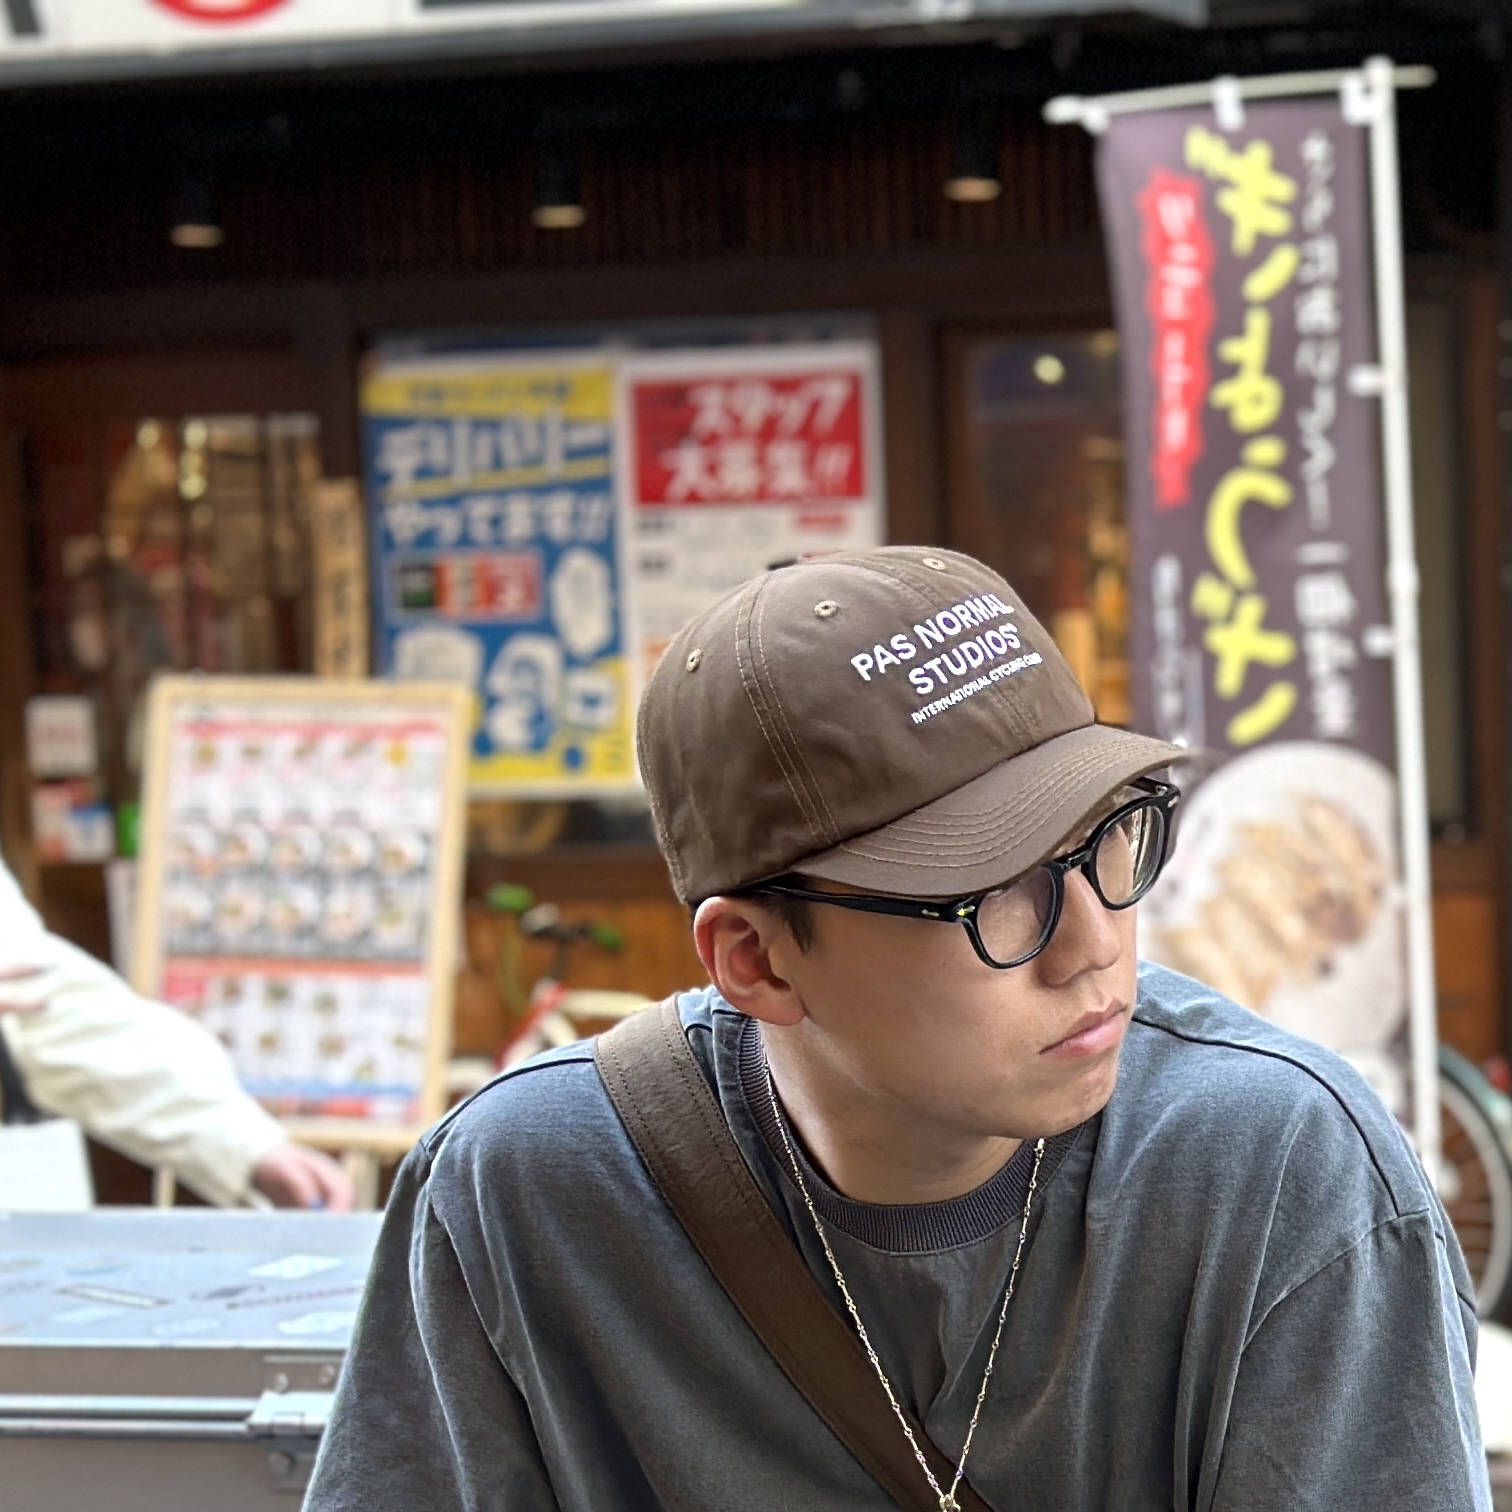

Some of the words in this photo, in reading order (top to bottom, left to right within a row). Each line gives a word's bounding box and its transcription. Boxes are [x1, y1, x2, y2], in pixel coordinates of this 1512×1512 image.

[688, 375, 852, 437] スタッフ
[376, 405, 611, 492] デリバリー
[850, 633, 917, 681] PAS
[913, 593, 1015, 650] NORMAL
[908, 622, 1022, 695] STUDIOS
[911, 675, 993, 724] INTERNATIONAL
